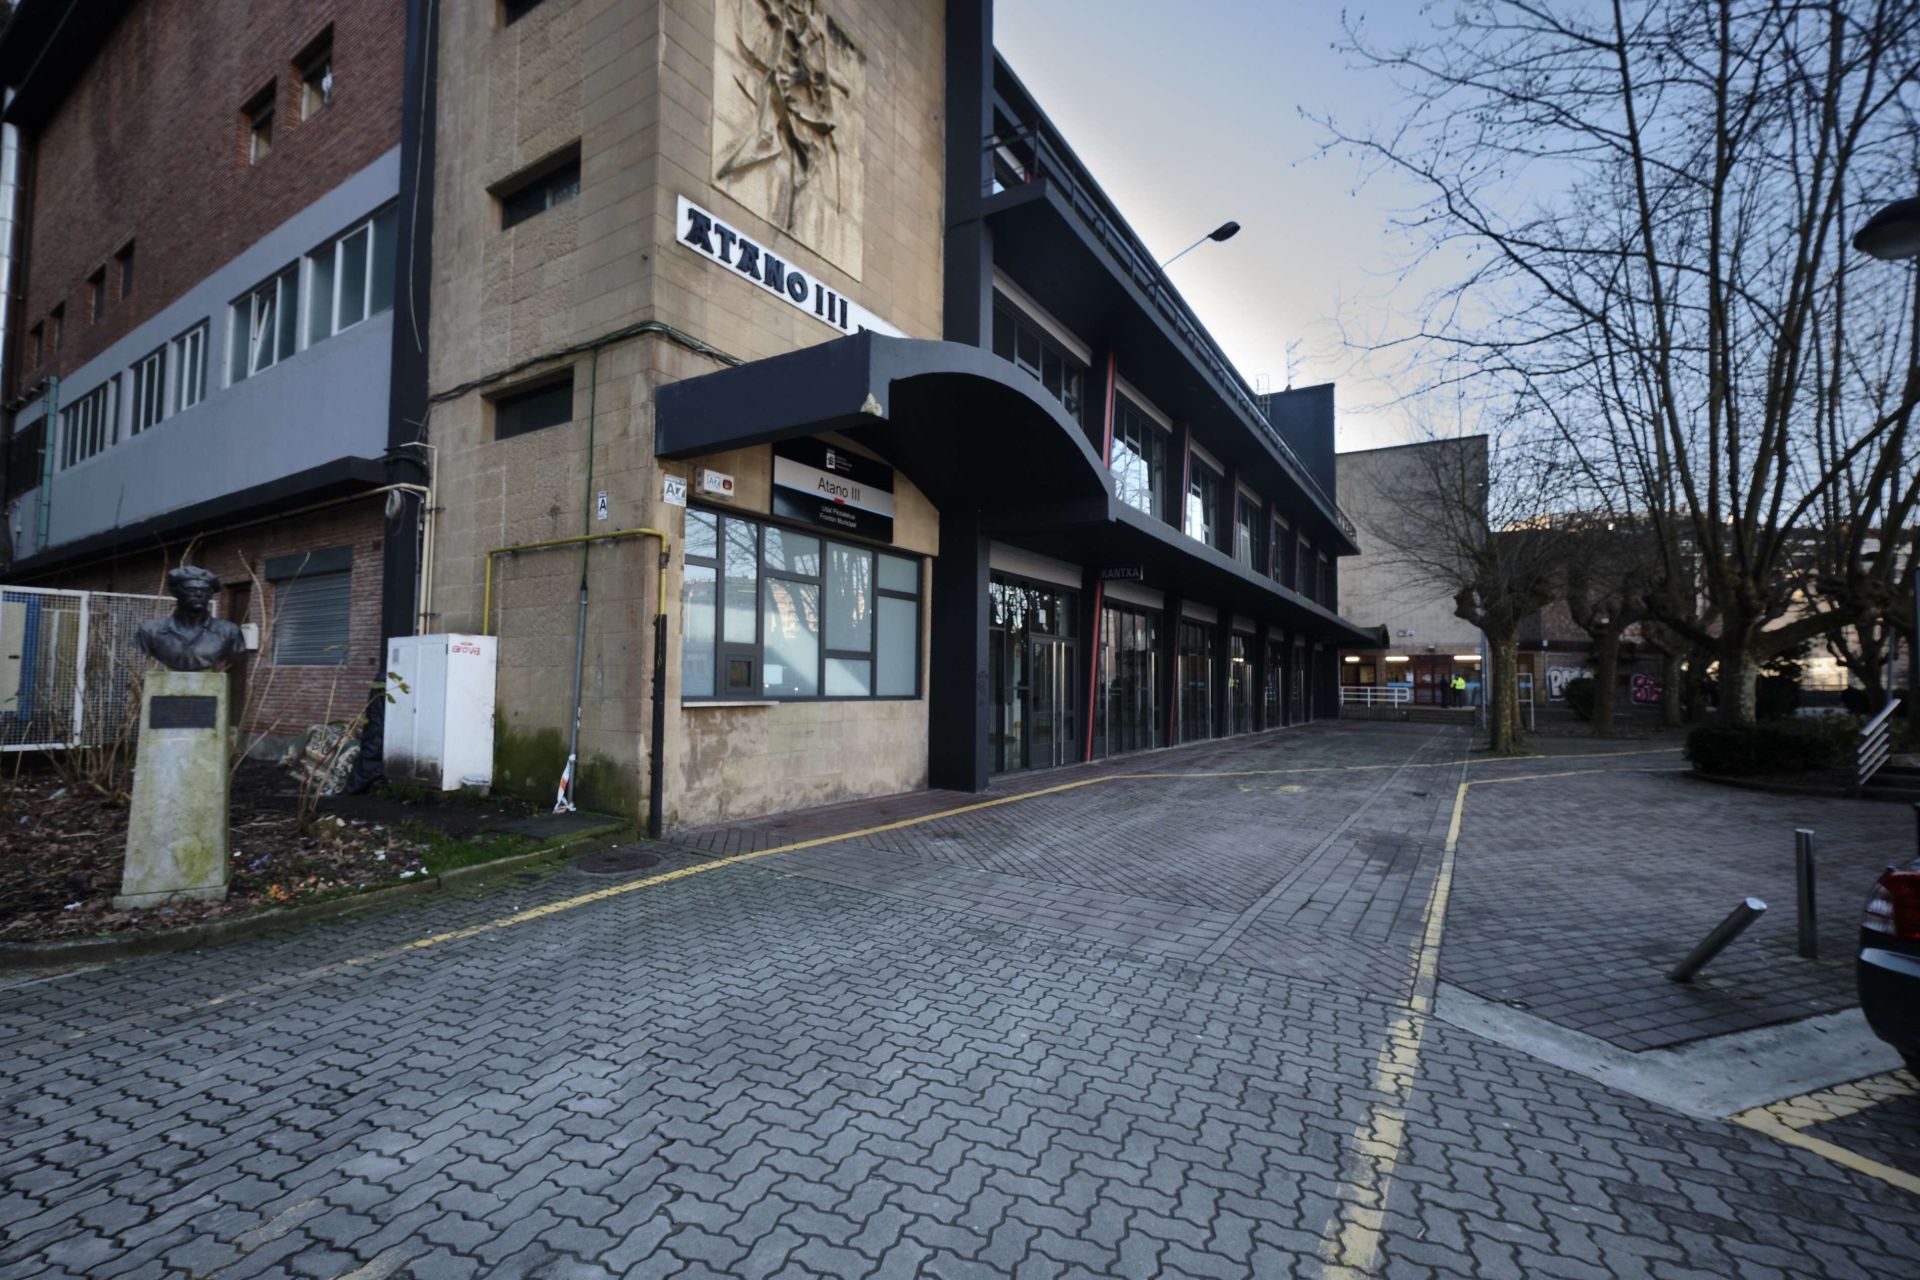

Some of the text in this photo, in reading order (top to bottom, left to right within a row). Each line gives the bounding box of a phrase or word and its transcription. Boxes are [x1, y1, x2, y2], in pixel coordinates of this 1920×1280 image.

[684, 207, 848, 330] ATANO III
[817, 477, 861, 501] Atano III
[1101, 567, 1140, 578] KANTXA
